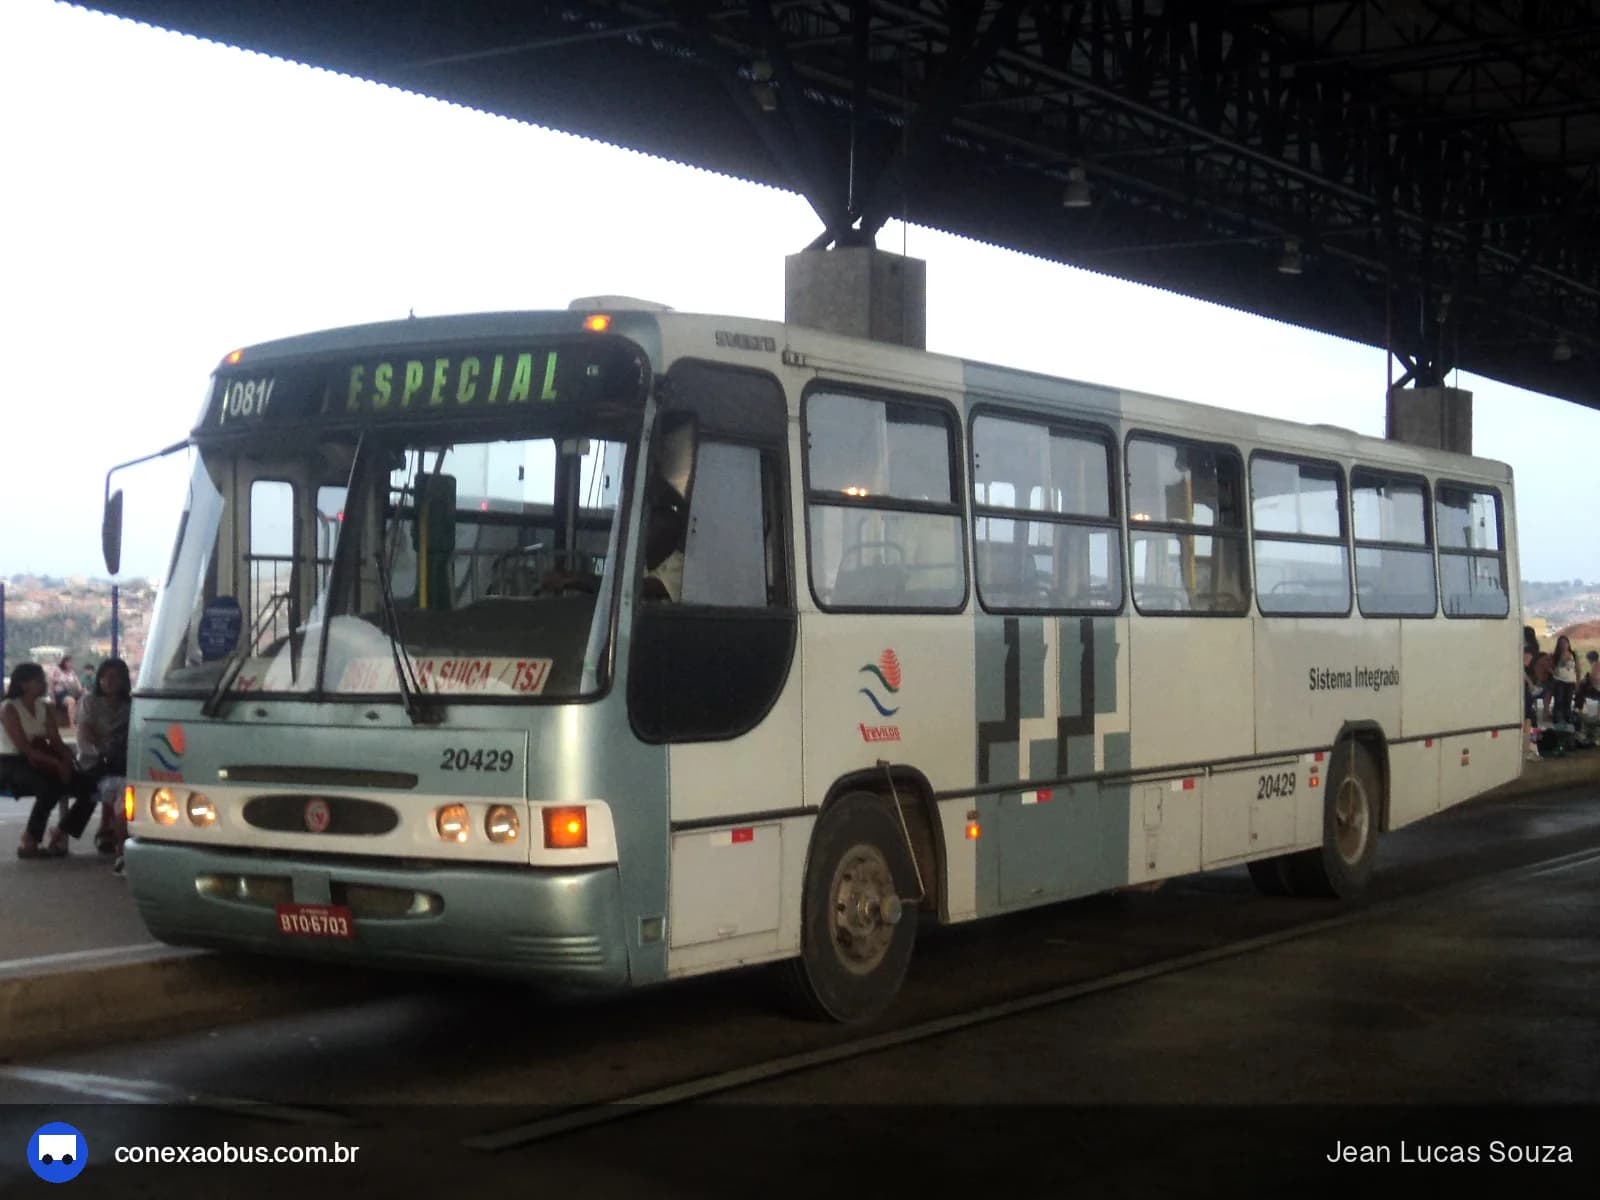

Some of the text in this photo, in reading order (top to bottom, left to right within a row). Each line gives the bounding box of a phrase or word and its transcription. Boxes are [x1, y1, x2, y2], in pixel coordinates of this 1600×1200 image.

[347, 352, 558, 410] ESPECIAL
[511, 661, 548, 691] TSJ
[1309, 665, 1400, 691] Sistema Integrado
[440, 748, 514, 772] 20429
[1257, 772, 1296, 800] 20429
